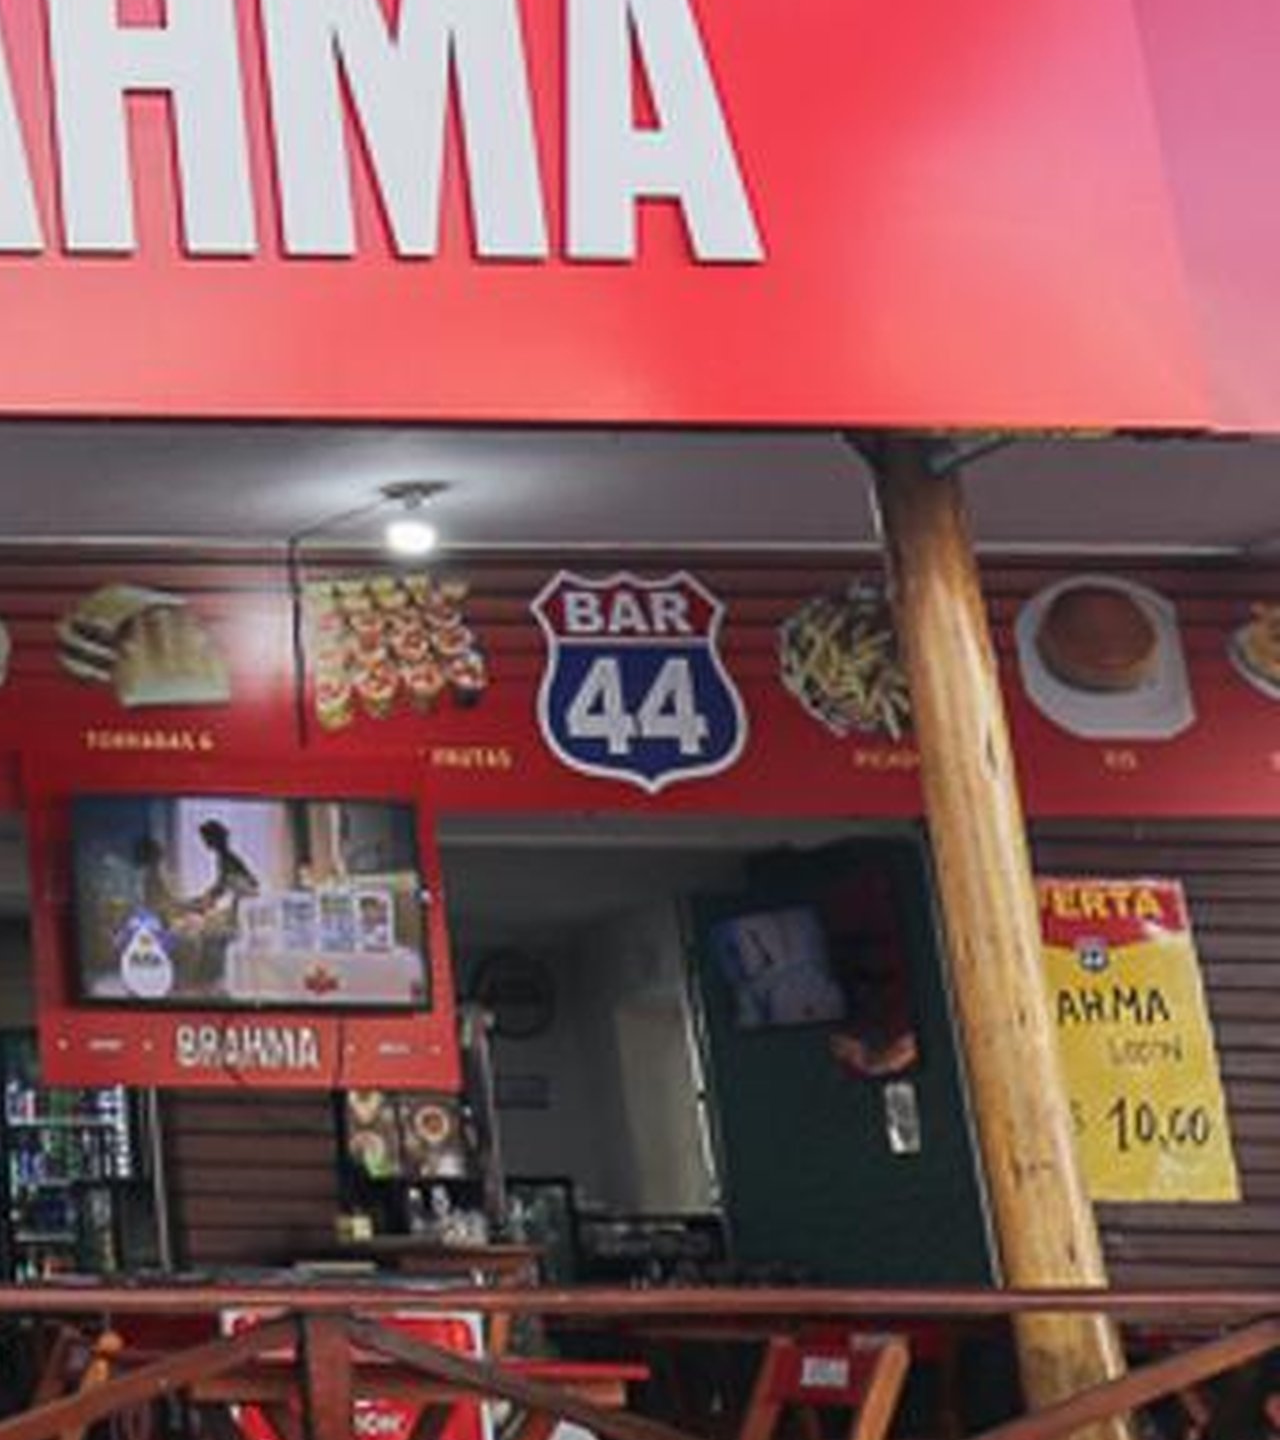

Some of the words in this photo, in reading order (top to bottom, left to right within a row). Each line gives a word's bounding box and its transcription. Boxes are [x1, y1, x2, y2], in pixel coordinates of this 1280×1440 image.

[562, 590, 692, 634] BAR
[564, 656, 710, 756] 44
[1050, 886, 1162, 920] ERTA
[1056, 986, 1172, 1026] AHMA
[175, 1024, 320, 1069] BRAHMA
